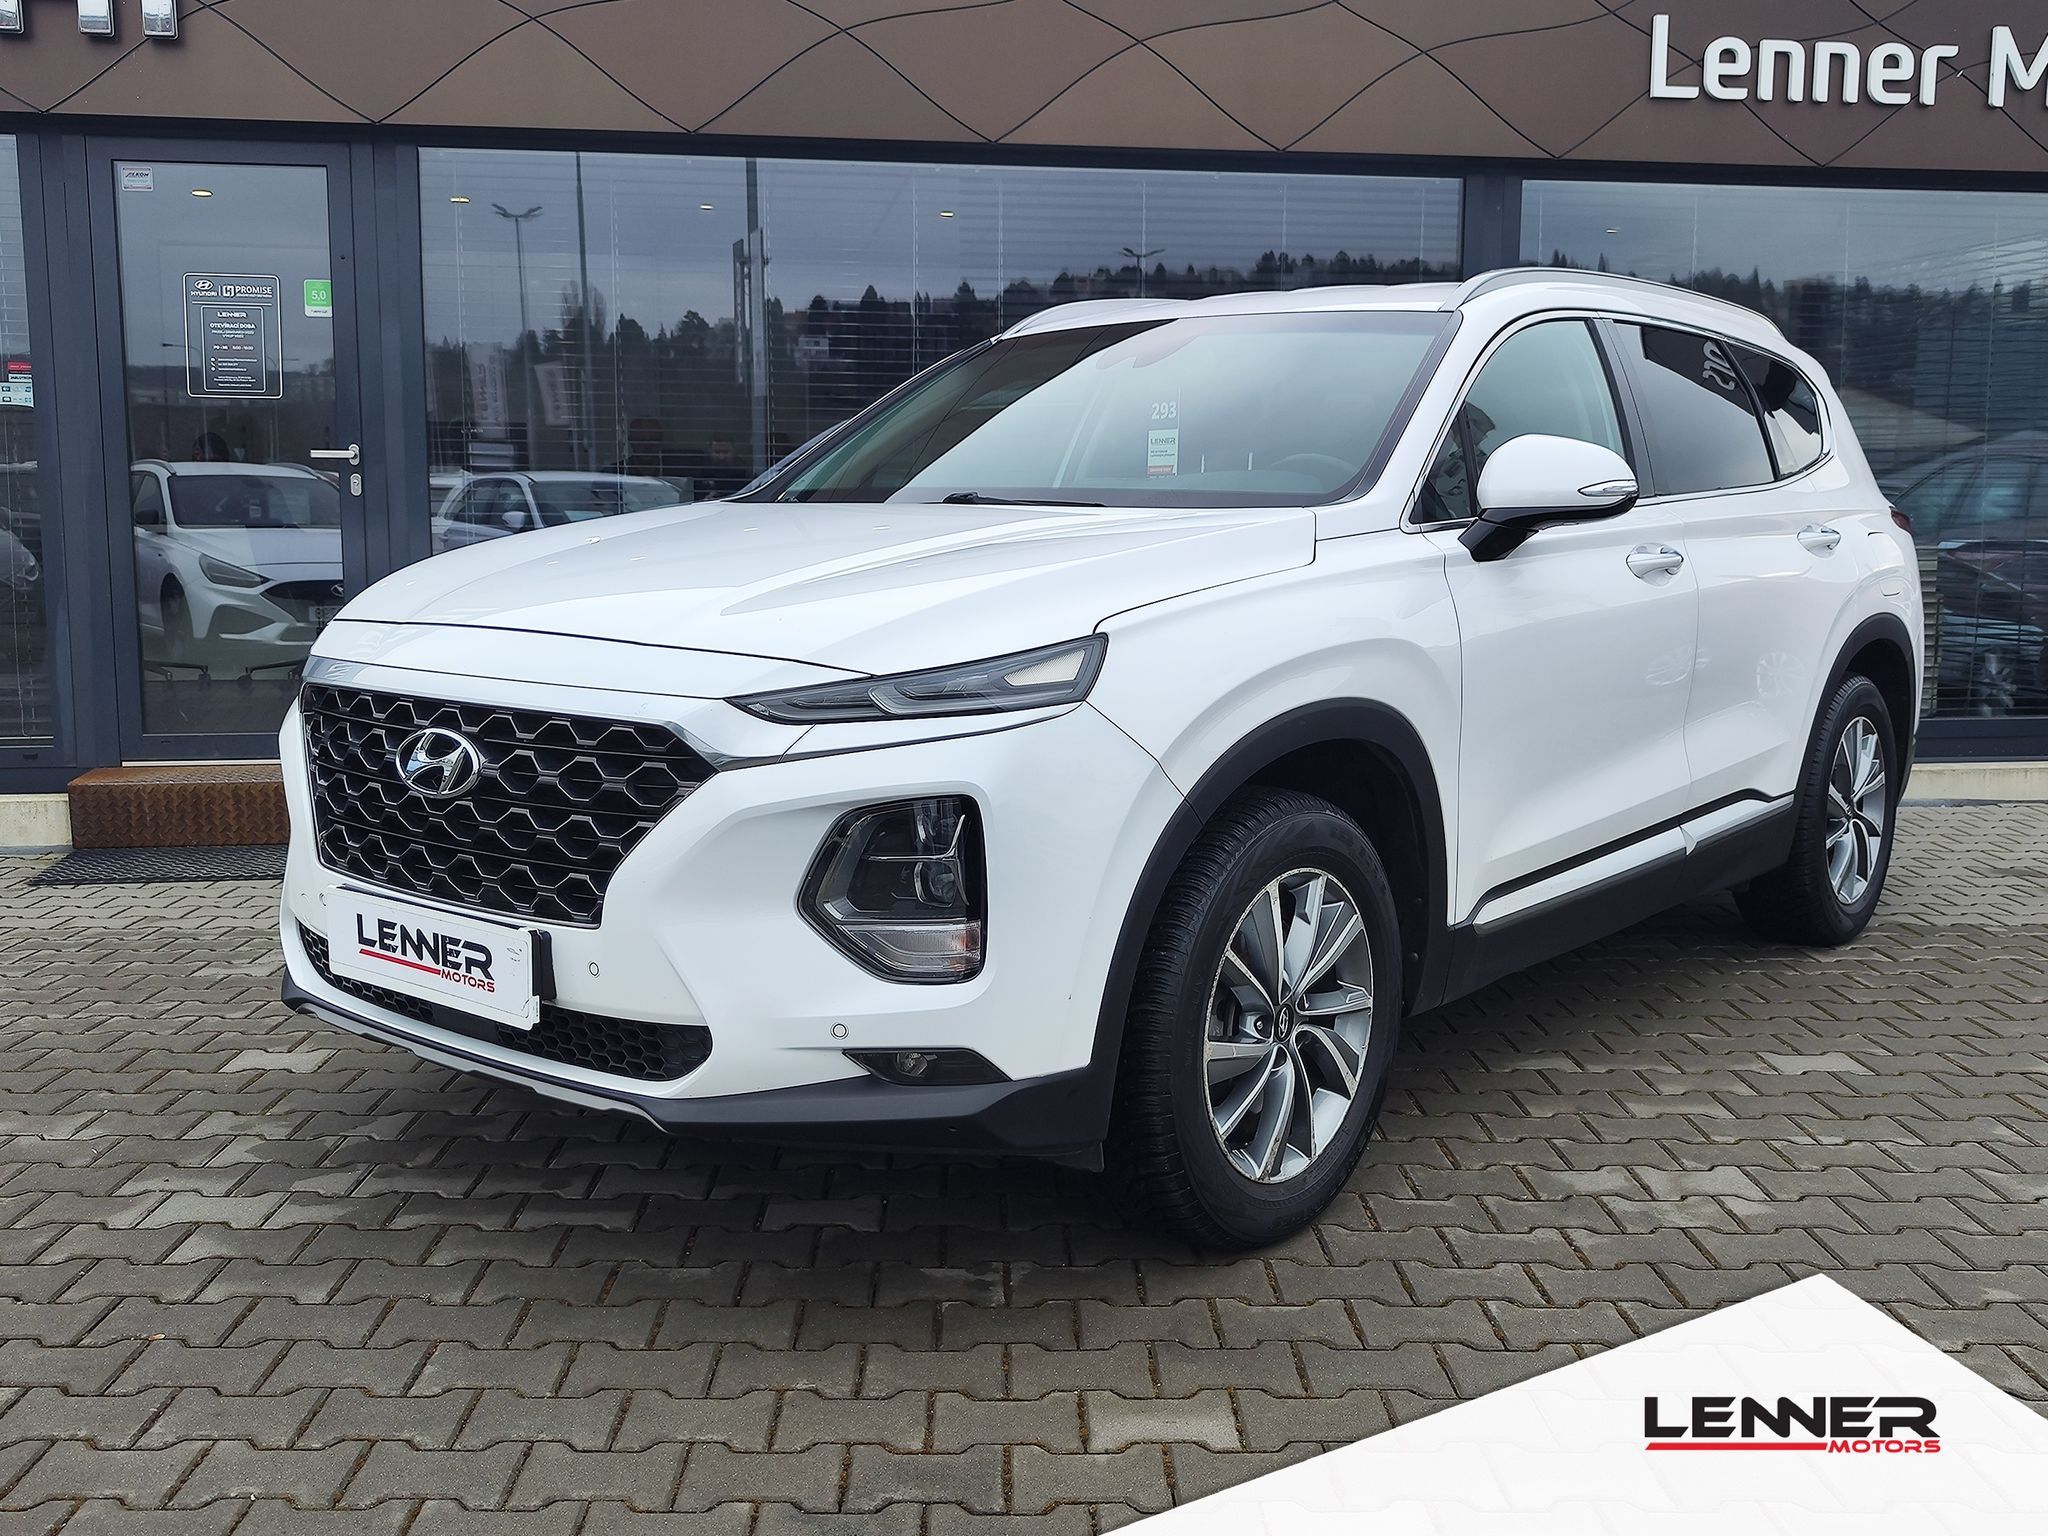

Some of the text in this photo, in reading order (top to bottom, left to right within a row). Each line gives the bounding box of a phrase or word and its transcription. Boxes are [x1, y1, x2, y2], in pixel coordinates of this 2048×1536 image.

[1649, 13, 1960, 106] Lenner
[235, 286, 273, 294] PROMISE
[311, 290, 327, 301] 5,0
[1151, 401, 1177, 420] 293
[356, 912, 495, 981] LENNER
[440, 968, 495, 993] MOTORS
